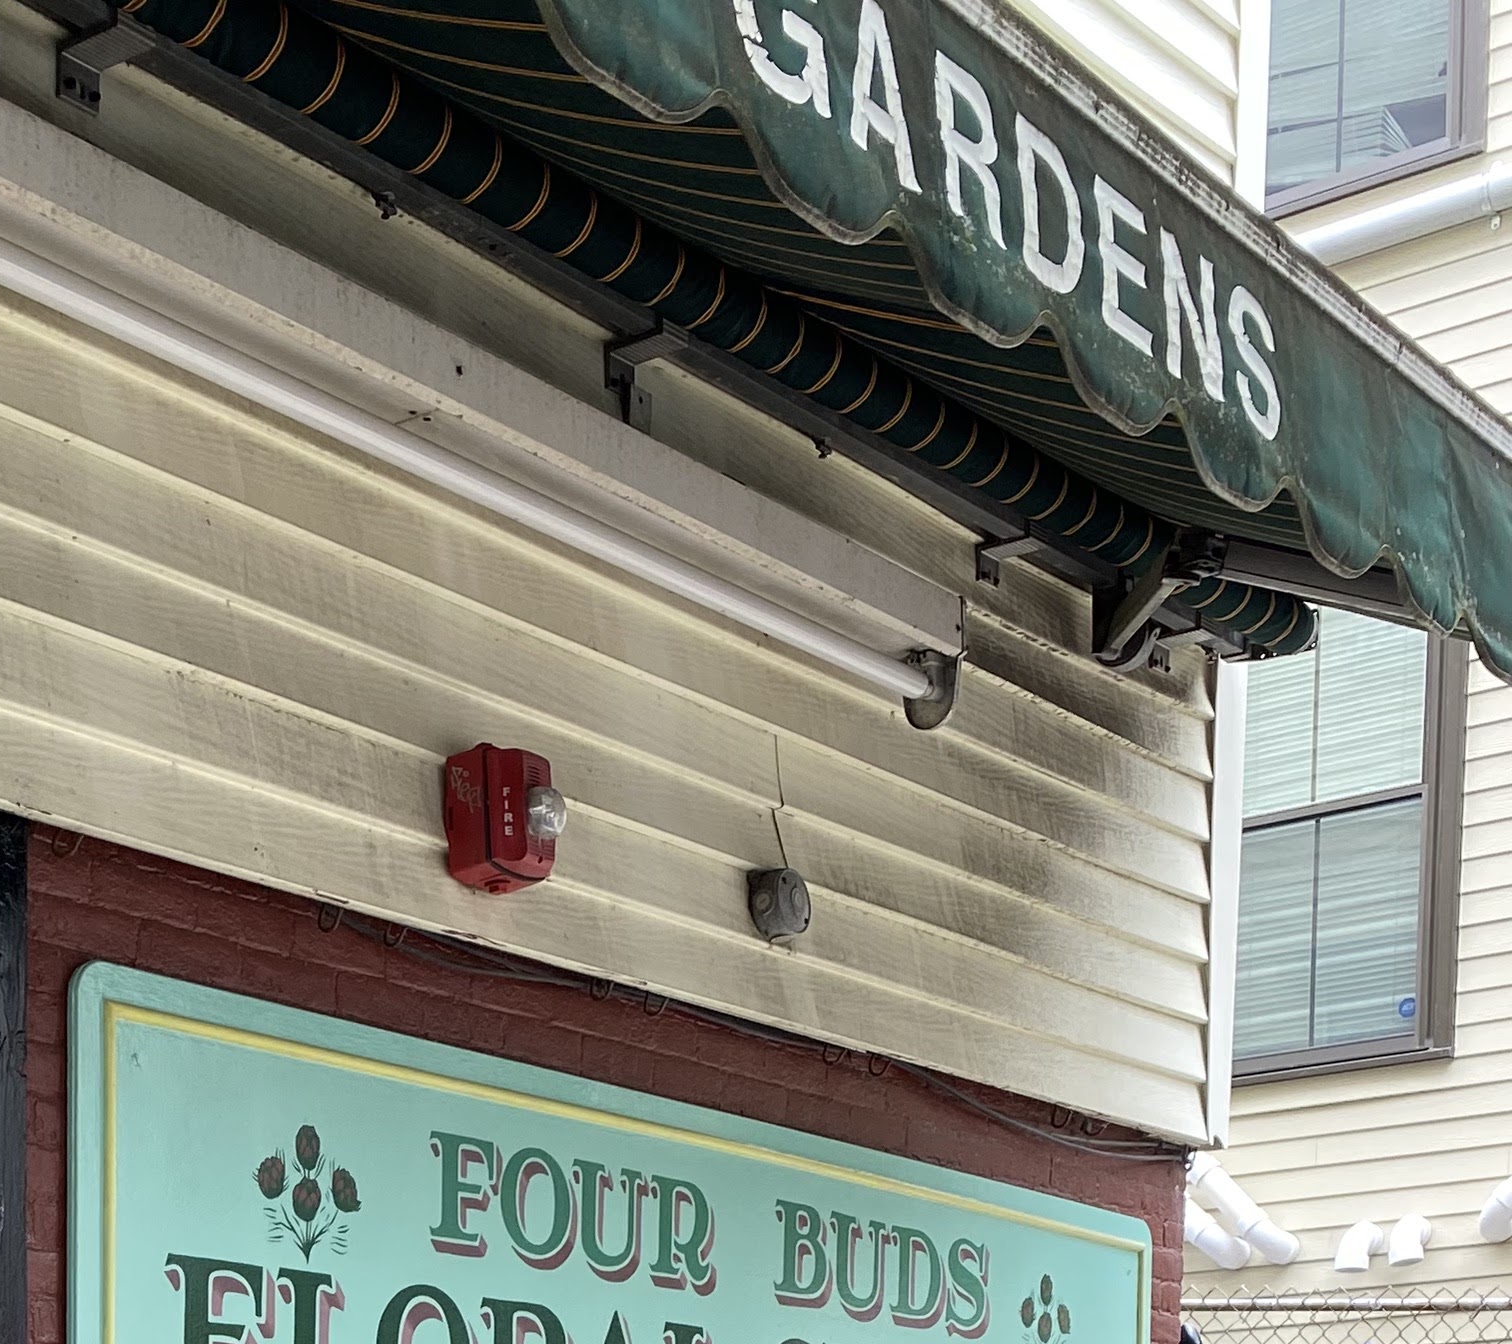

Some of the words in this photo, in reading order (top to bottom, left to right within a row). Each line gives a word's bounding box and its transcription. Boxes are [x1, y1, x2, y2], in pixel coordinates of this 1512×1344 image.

[734, 0, 1281, 441] GARDENS
[502, 786, 514, 836] FIRE
[429, 1130, 717, 1296] FOUR
[773, 1198, 991, 1341] BUDS
